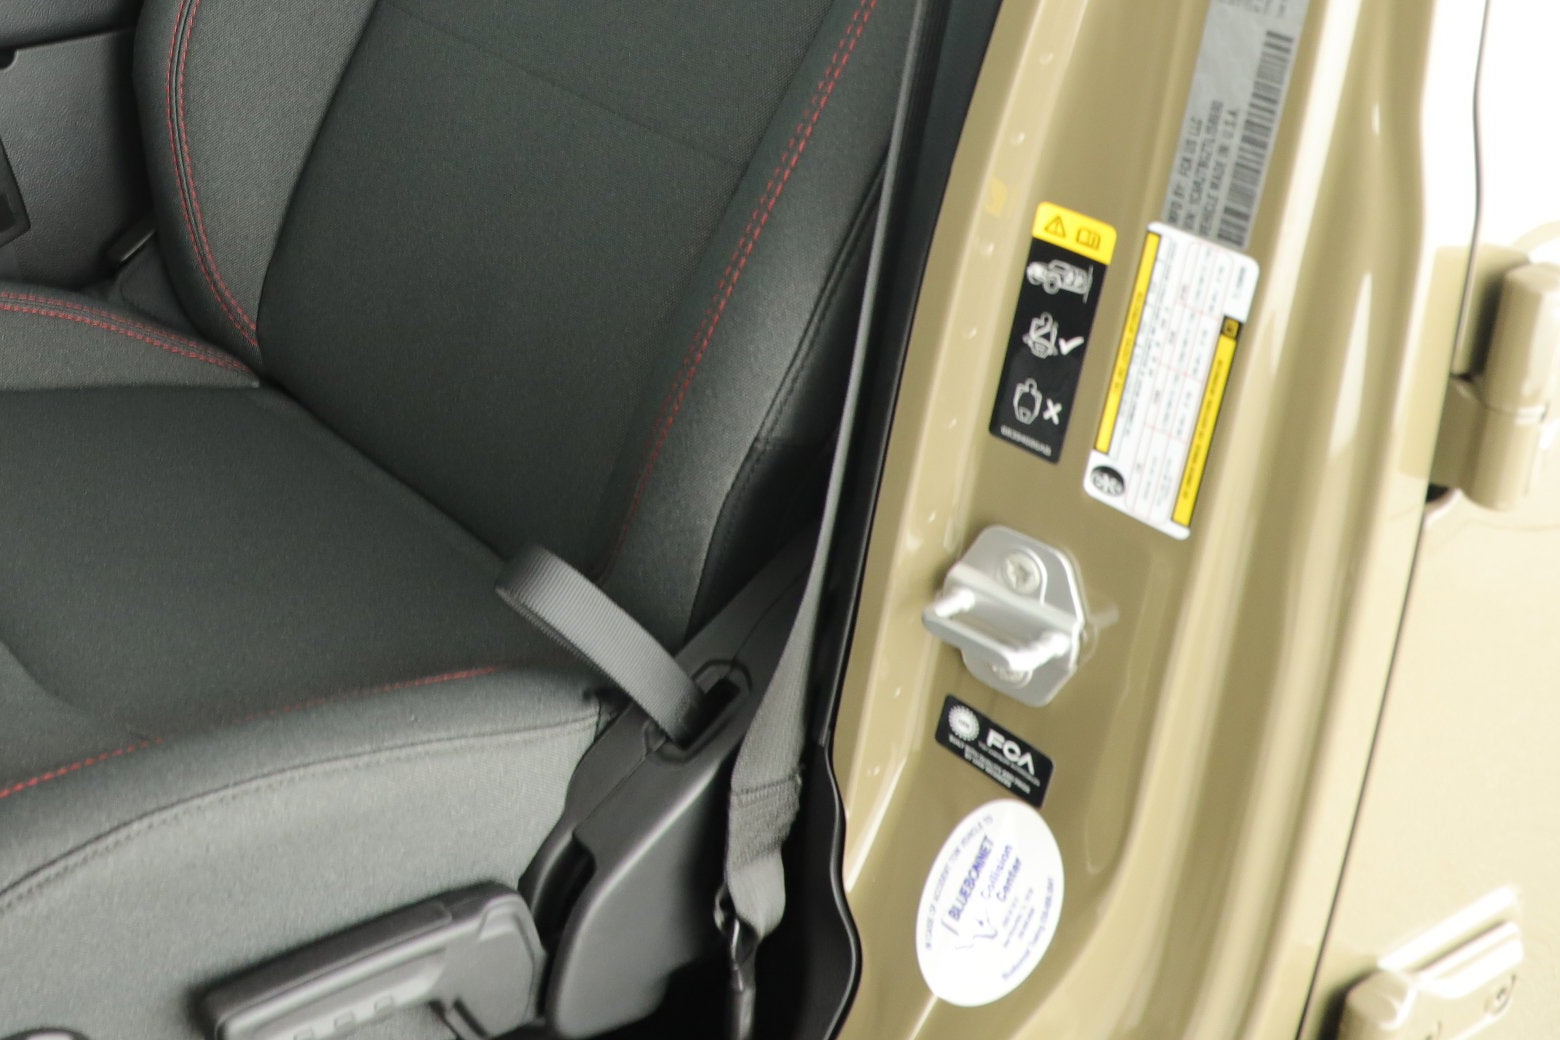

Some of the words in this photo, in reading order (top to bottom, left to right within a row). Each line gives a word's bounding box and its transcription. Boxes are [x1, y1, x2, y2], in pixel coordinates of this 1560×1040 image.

[987, 728, 1034, 774] FCA
[946, 832, 995, 922] BLUEBONNET
[978, 843, 1012, 900] Collision
[994, 856, 1022, 903] Center
